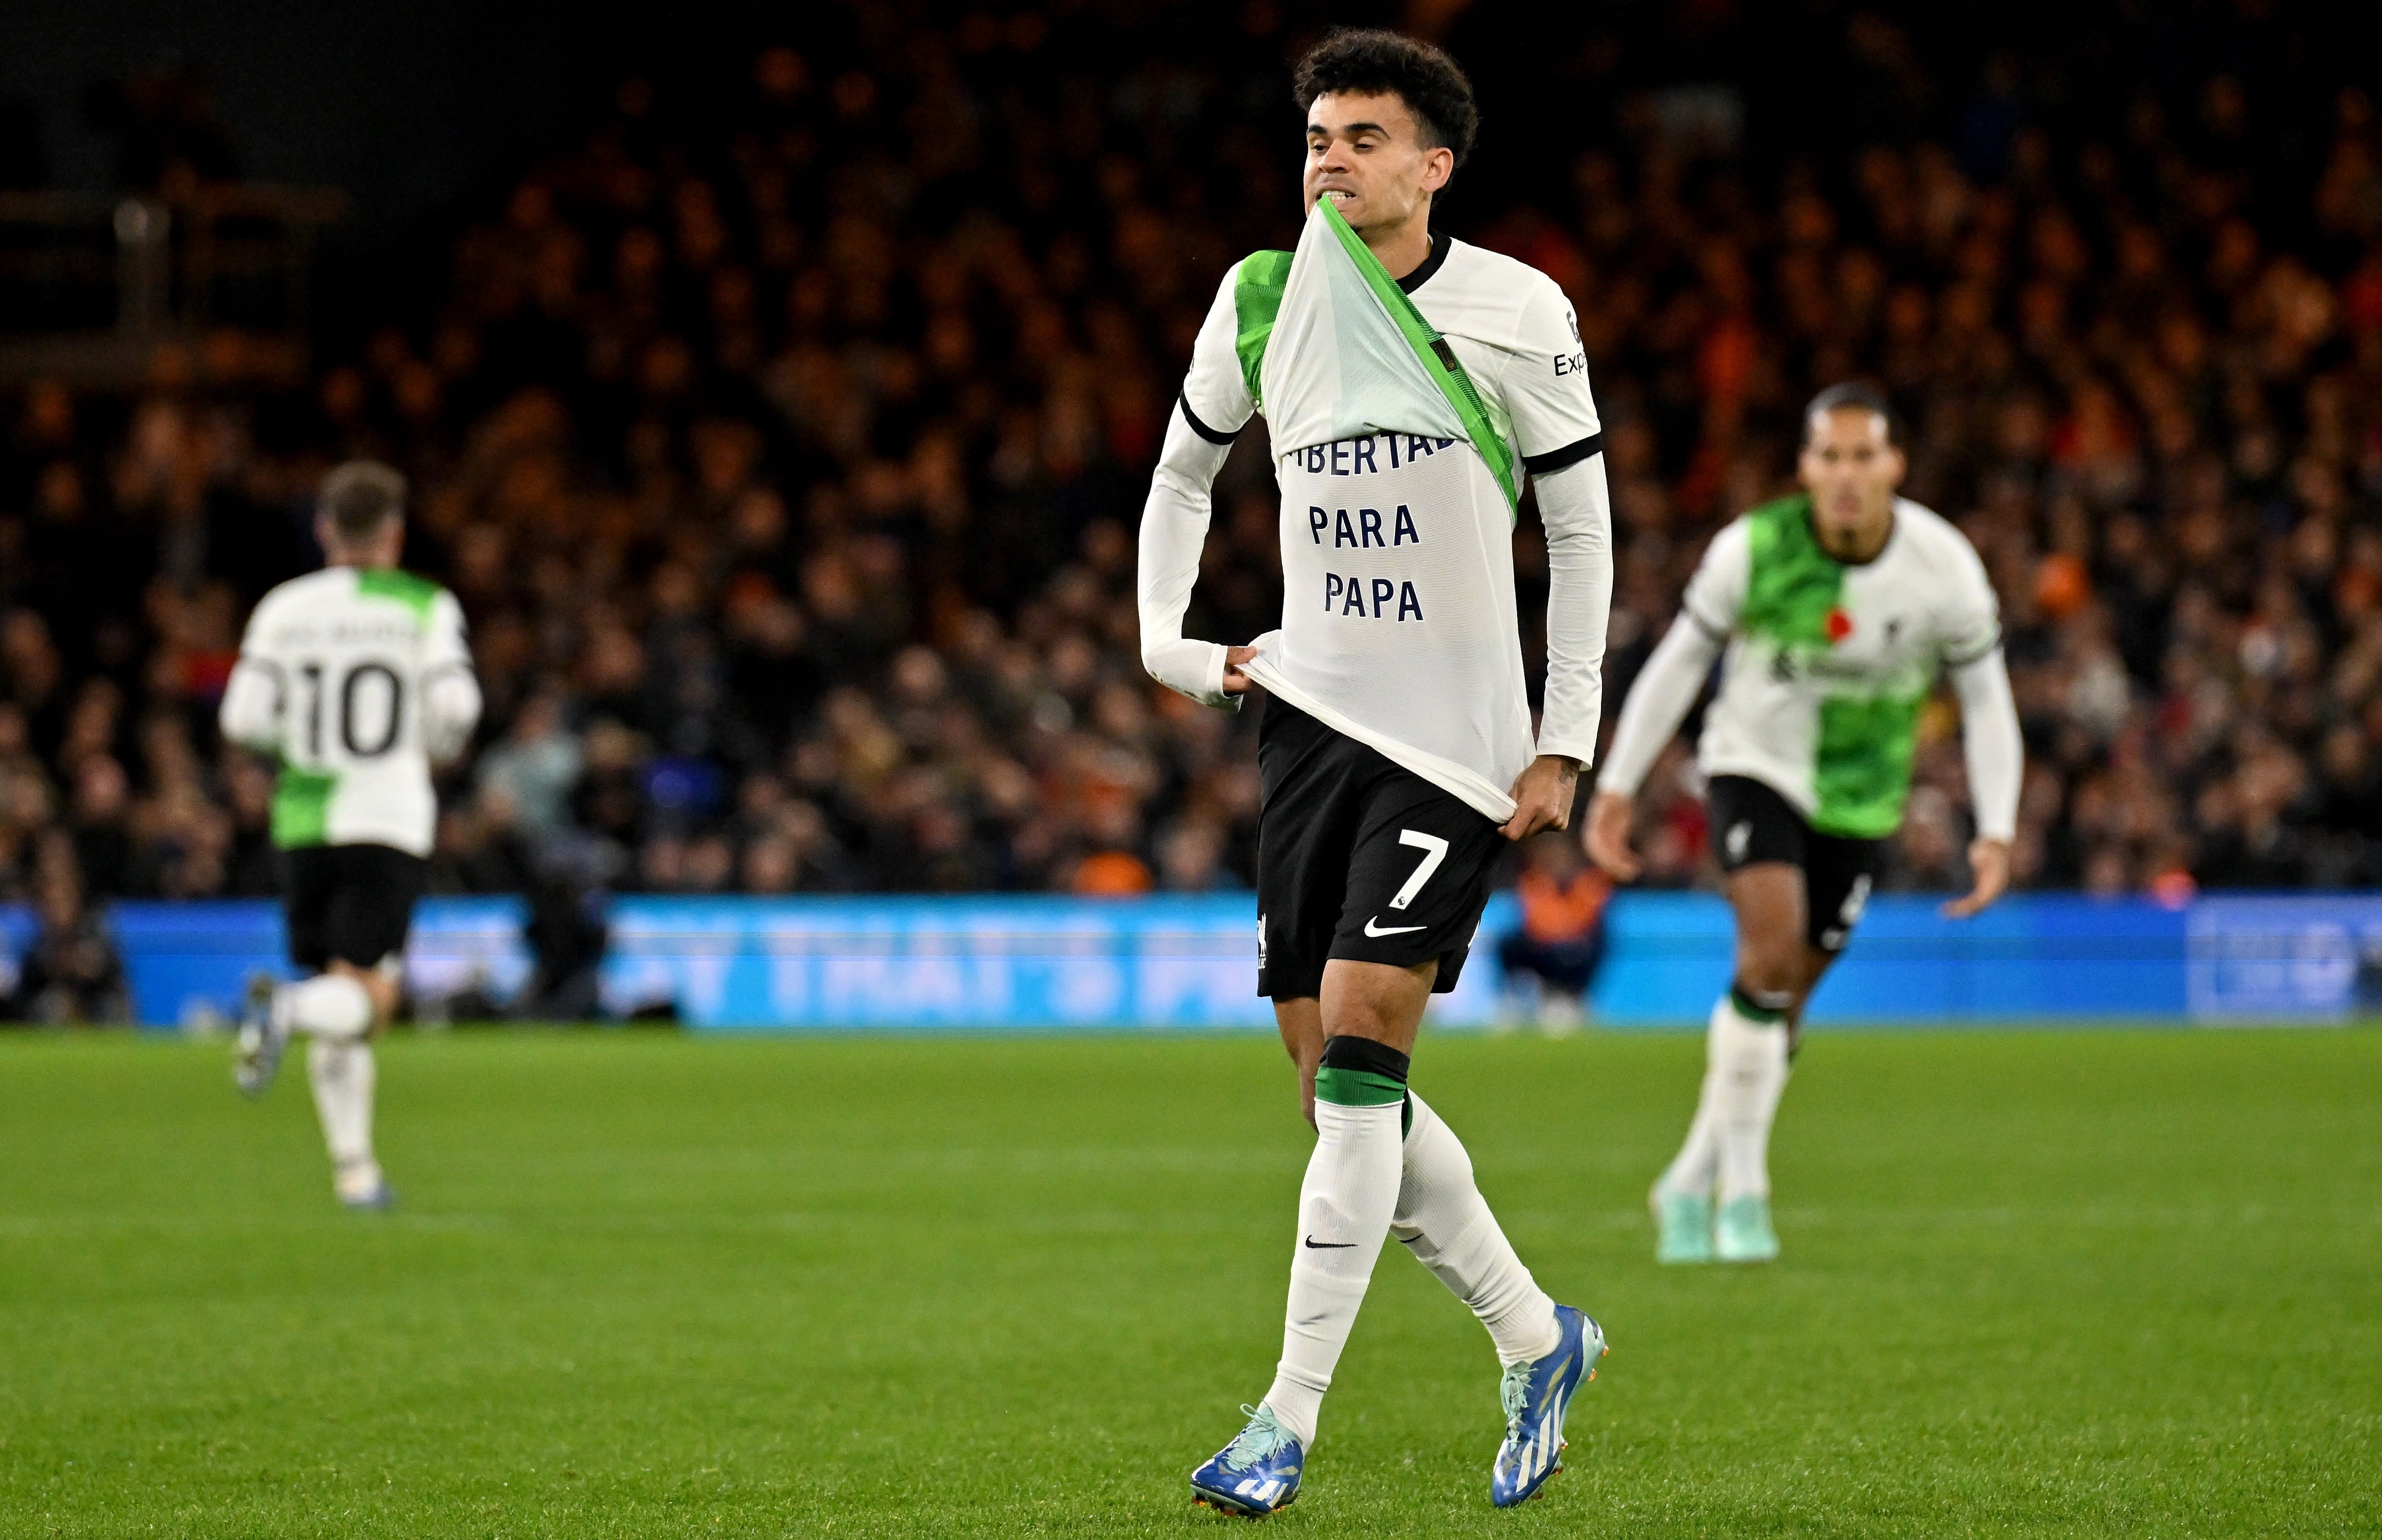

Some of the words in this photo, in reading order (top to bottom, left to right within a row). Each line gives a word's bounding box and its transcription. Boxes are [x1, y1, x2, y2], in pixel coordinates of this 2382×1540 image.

[1554, 350, 1587, 376] Exp
[1287, 430, 1456, 476] BERTA
[1309, 504, 1420, 549] PARA
[1324, 571, 1424, 622] PAPA
[302, 662, 403, 758] 10
[1388, 829, 1449, 910] 7
